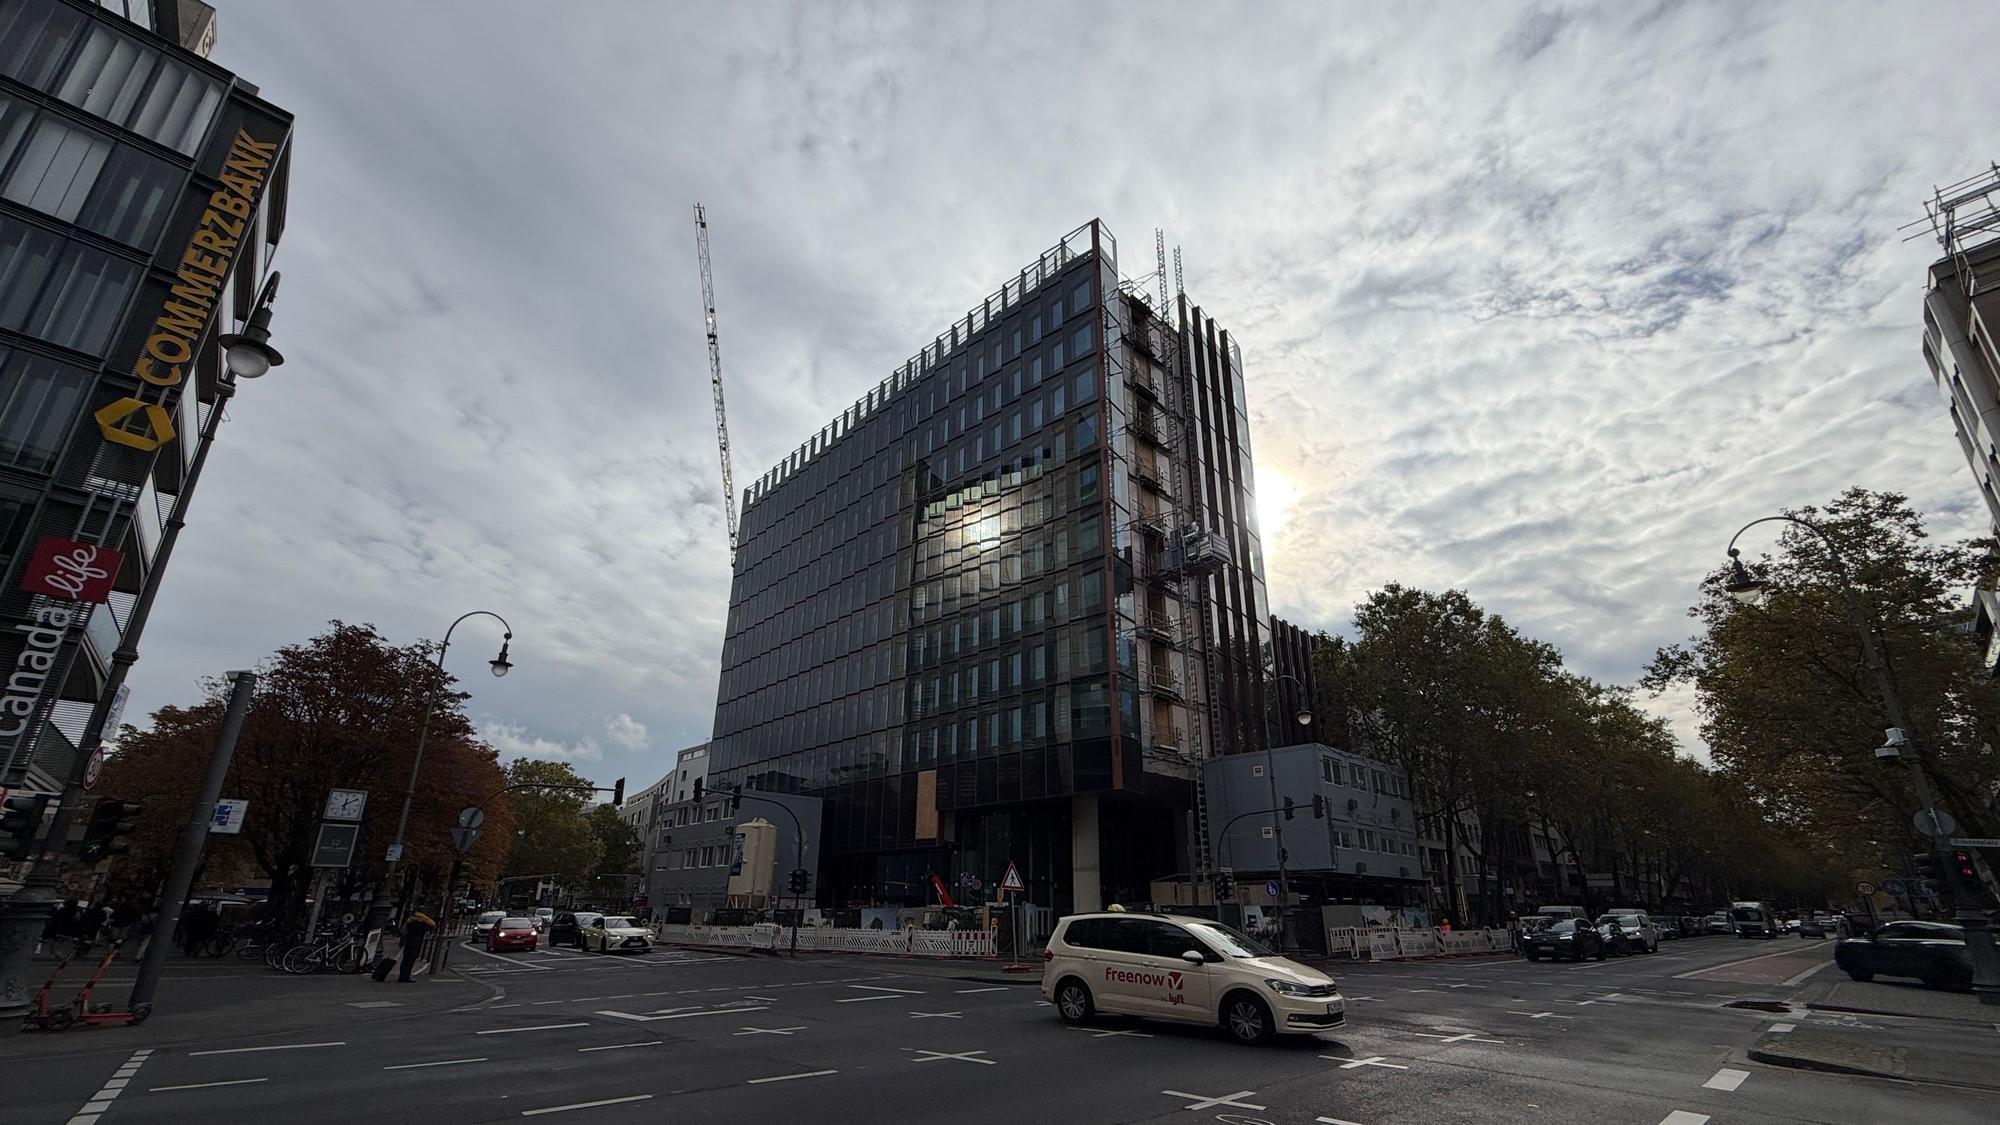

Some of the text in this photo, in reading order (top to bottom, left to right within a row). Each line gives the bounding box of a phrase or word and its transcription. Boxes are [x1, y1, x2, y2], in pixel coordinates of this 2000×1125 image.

[136, 128, 277, 387] COMMERZBANK
[44, 544, 108, 599] life
[1105, 967, 1165, 986] freenow
